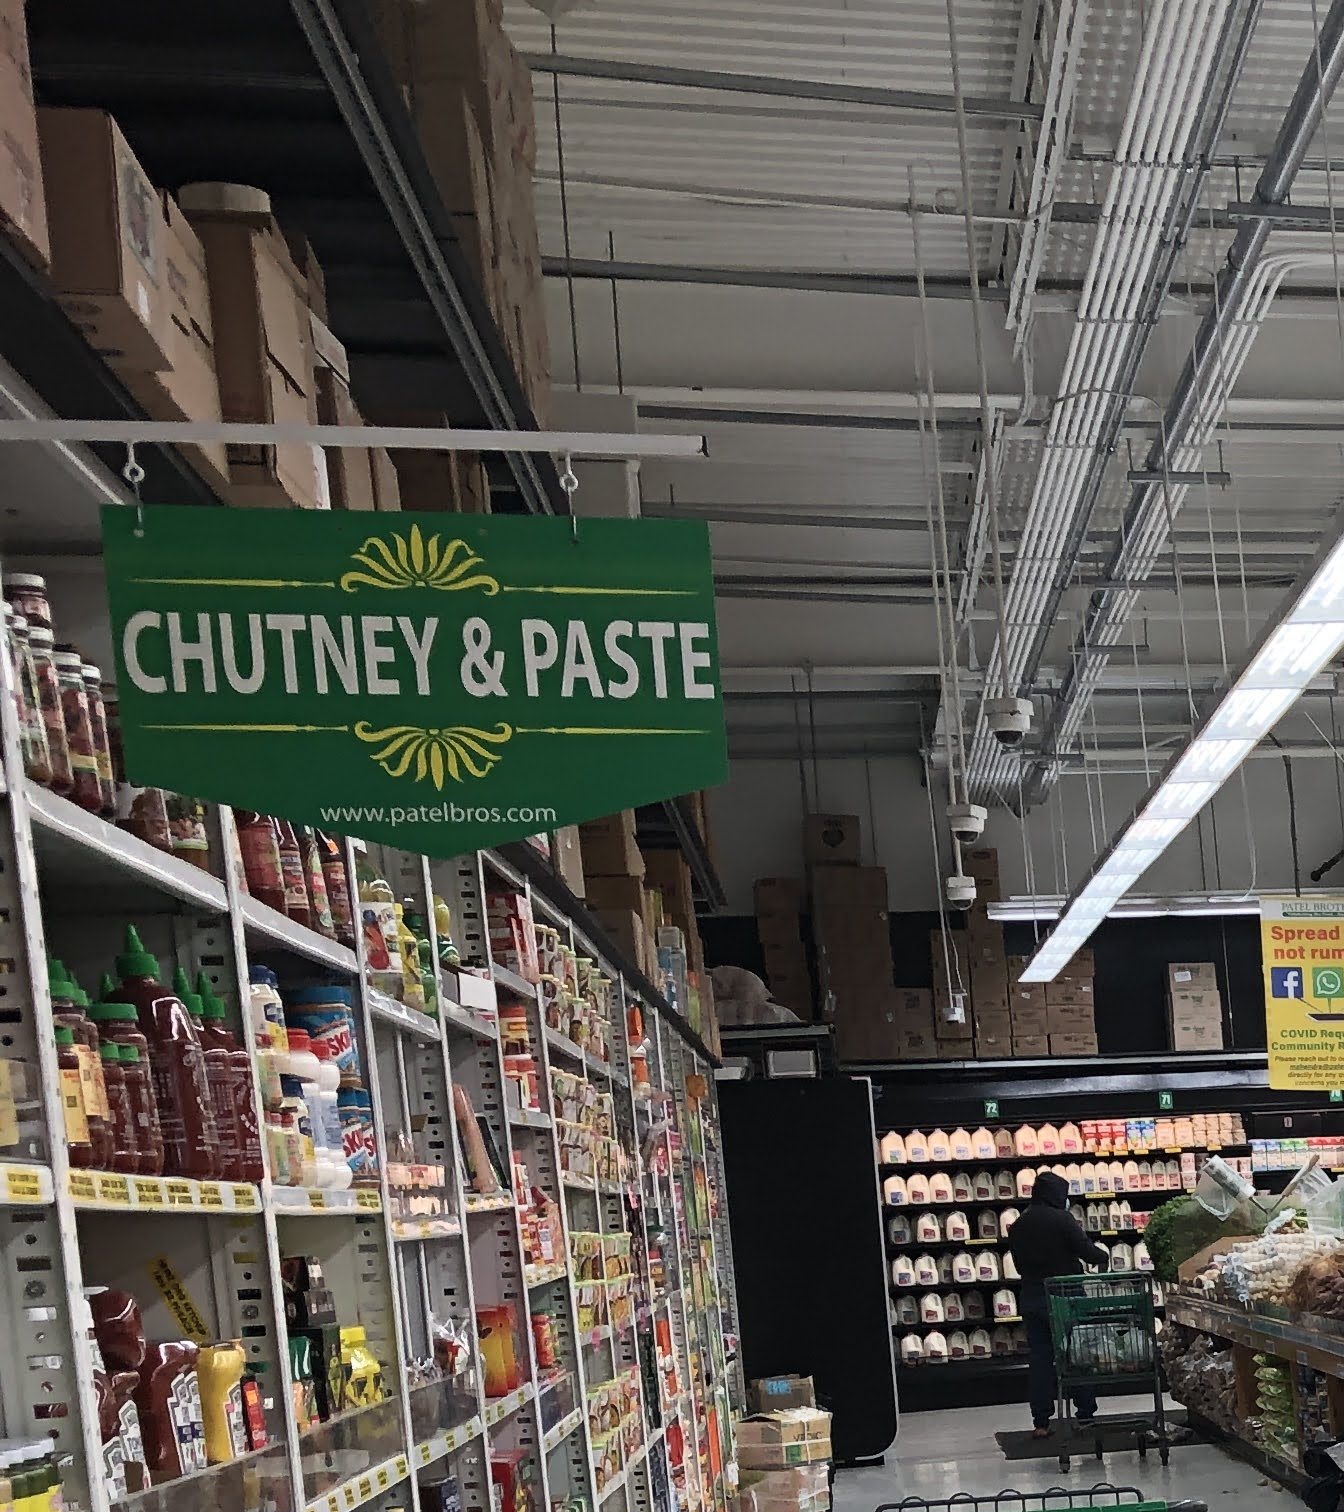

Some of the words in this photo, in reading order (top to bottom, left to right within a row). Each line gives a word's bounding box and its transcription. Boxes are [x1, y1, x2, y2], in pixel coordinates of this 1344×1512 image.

[122, 610, 438, 695] CHUTNEY
[461, 617, 508, 697] &
[521, 618, 714, 699] PASTE
[320, 801, 556, 826] www.patelbros.com
[1282, 902, 1311, 911] PATEL
[1271, 926, 1342, 944] Spread
[1274, 946, 1307, 960] not
[1281, 1030, 1317, 1038] COVID
[1271, 1042, 1335, 1052] Community
